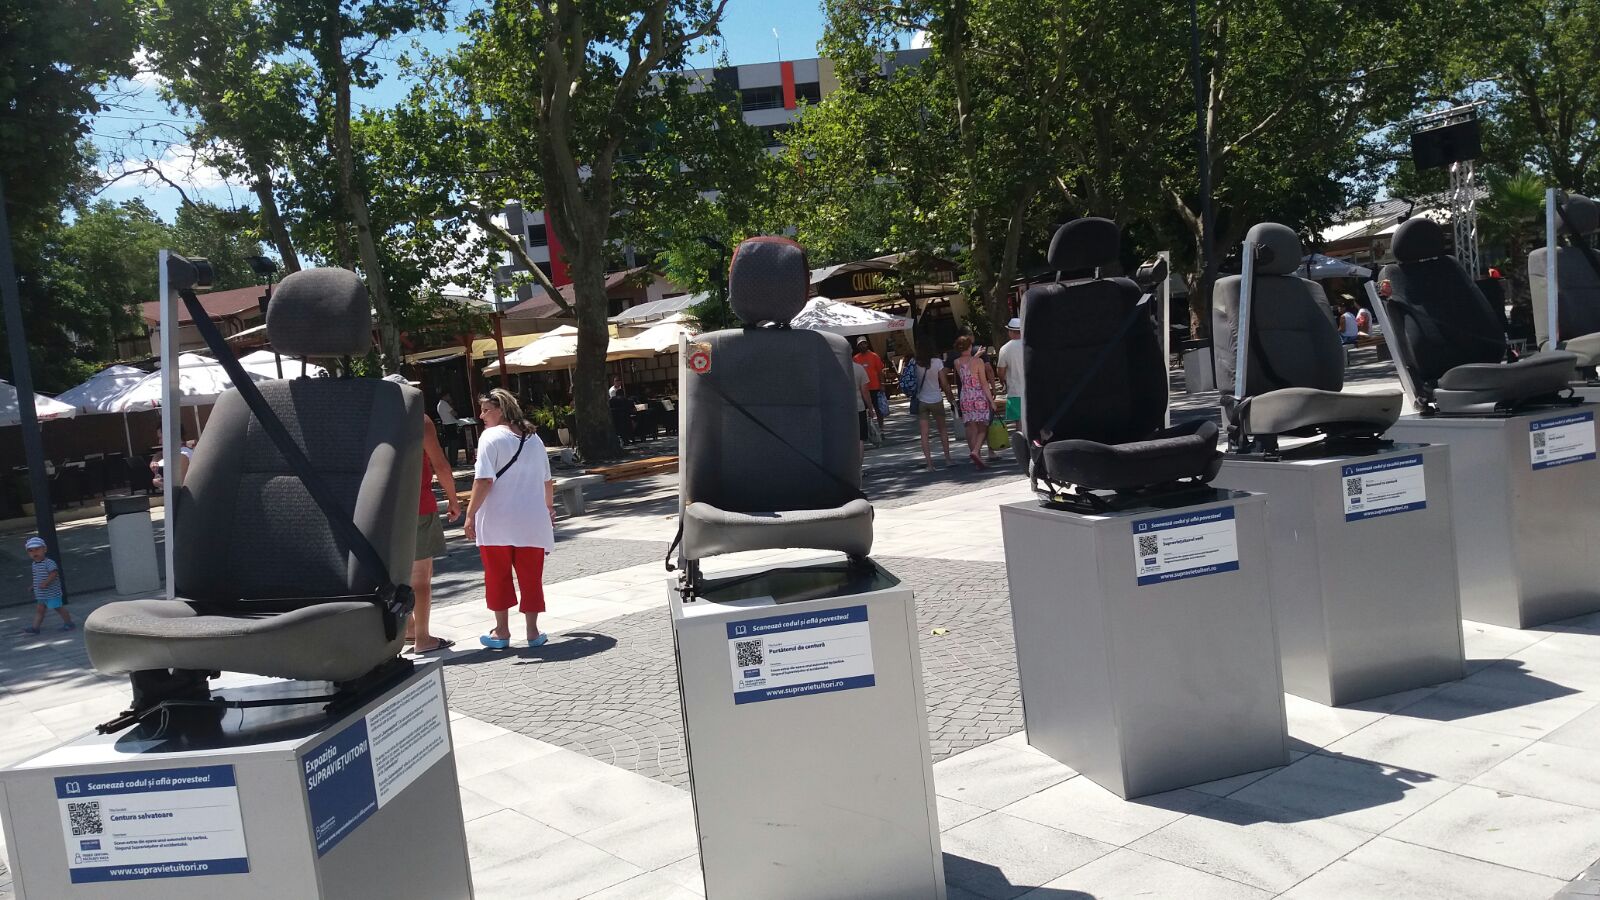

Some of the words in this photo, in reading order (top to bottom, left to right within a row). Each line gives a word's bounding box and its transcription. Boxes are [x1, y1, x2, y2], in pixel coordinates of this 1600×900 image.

[783, 619, 800, 628] codul
[766, 680, 844, 696] www.supravietuitori.ro
[87, 780, 125, 791] Scanează
[125, 779, 147, 789] codul
[171, 774, 211, 787] povestea!
[110, 813, 137, 822] Centura
[137, 811, 174, 820] salvatoare
[109, 862, 209, 877] www.supravietuitori.ro
